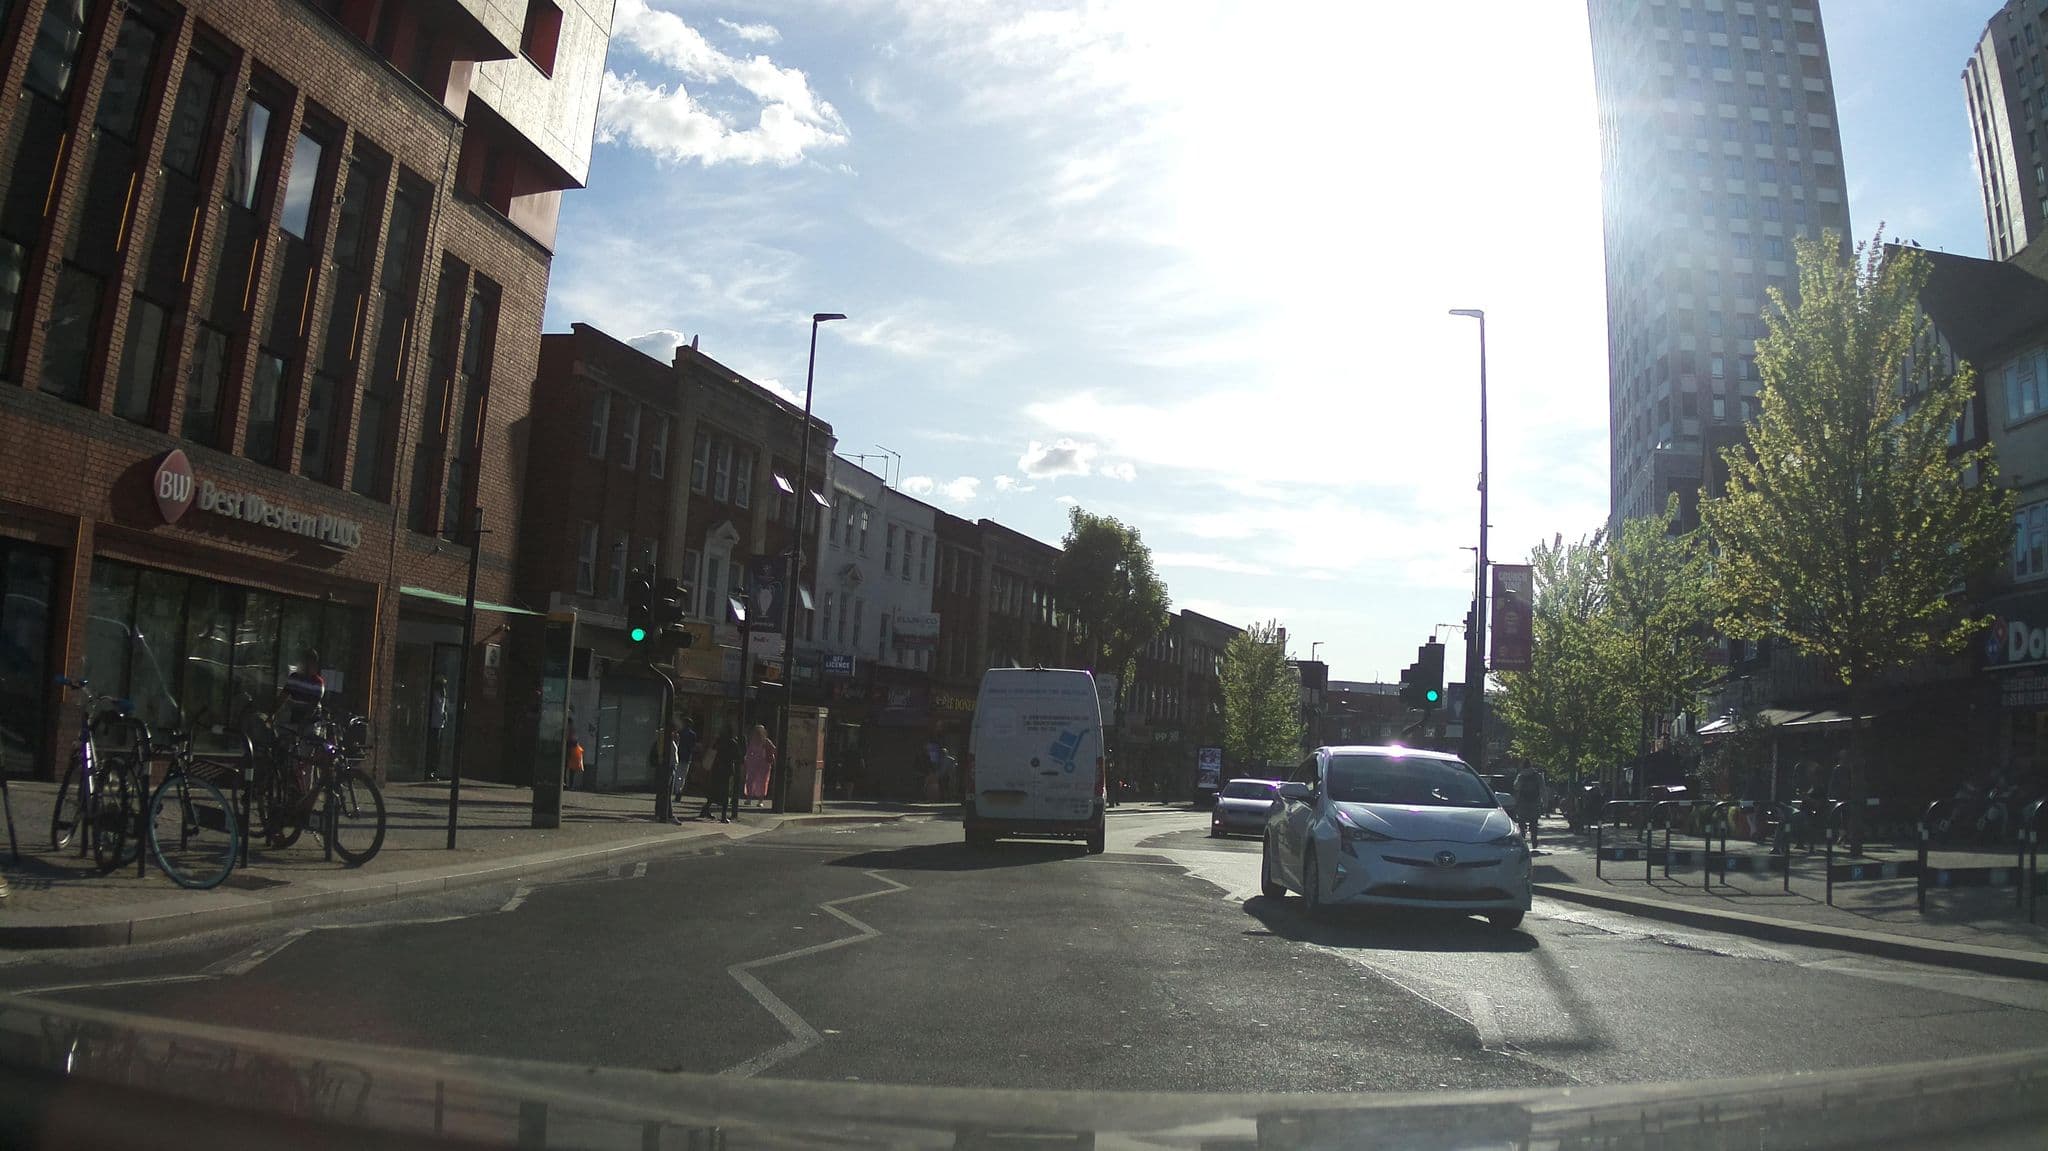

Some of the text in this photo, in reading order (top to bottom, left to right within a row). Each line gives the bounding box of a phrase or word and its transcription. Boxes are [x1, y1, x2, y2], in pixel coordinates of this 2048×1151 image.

[159, 470, 191, 502] BW
[198, 480, 243, 519] Best
[244, 493, 316, 538] Western
[2008, 621, 2048, 662] Do
[825, 661, 850, 669] LICENCE
